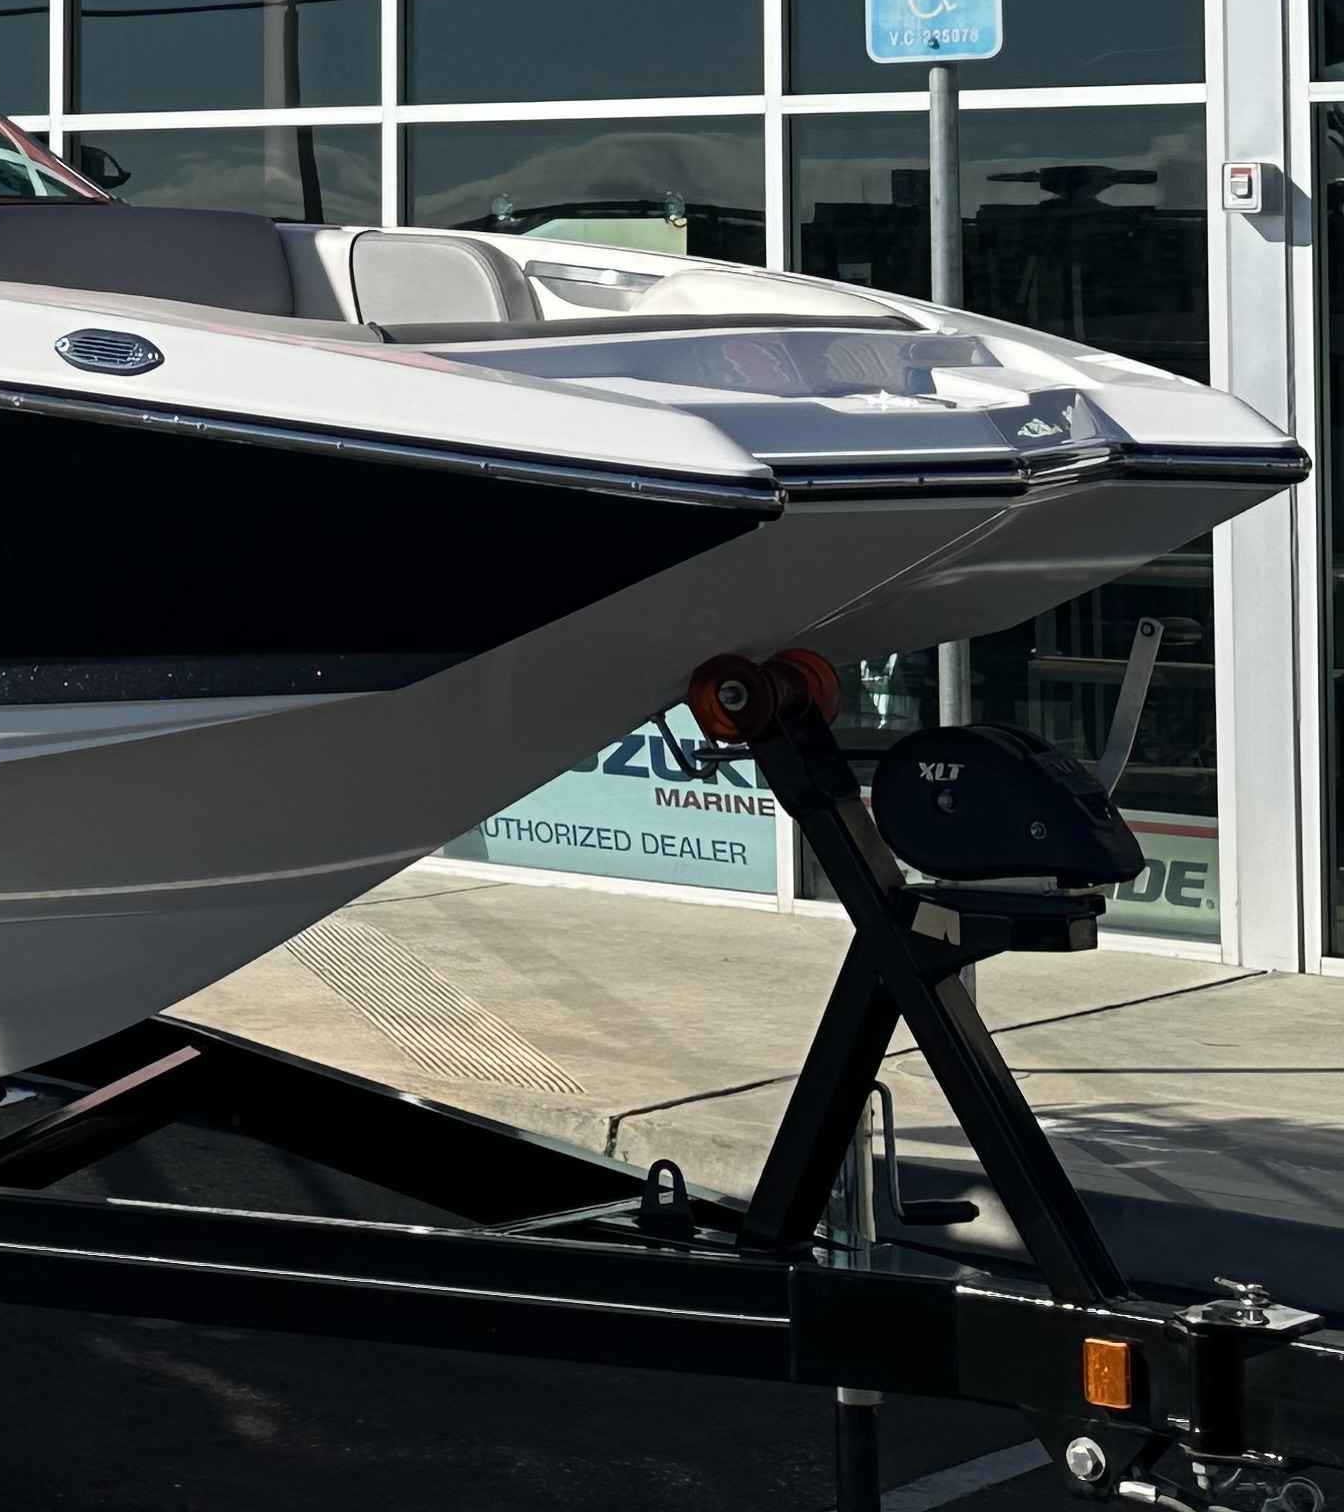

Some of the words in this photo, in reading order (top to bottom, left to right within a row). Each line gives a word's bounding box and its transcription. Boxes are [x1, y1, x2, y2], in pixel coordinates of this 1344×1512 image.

[569, 733, 772, 790] ZUK
[918, 761, 966, 783] XLT
[654, 786, 777, 818] MARINE
[641, 832, 748, 866] DEALER
